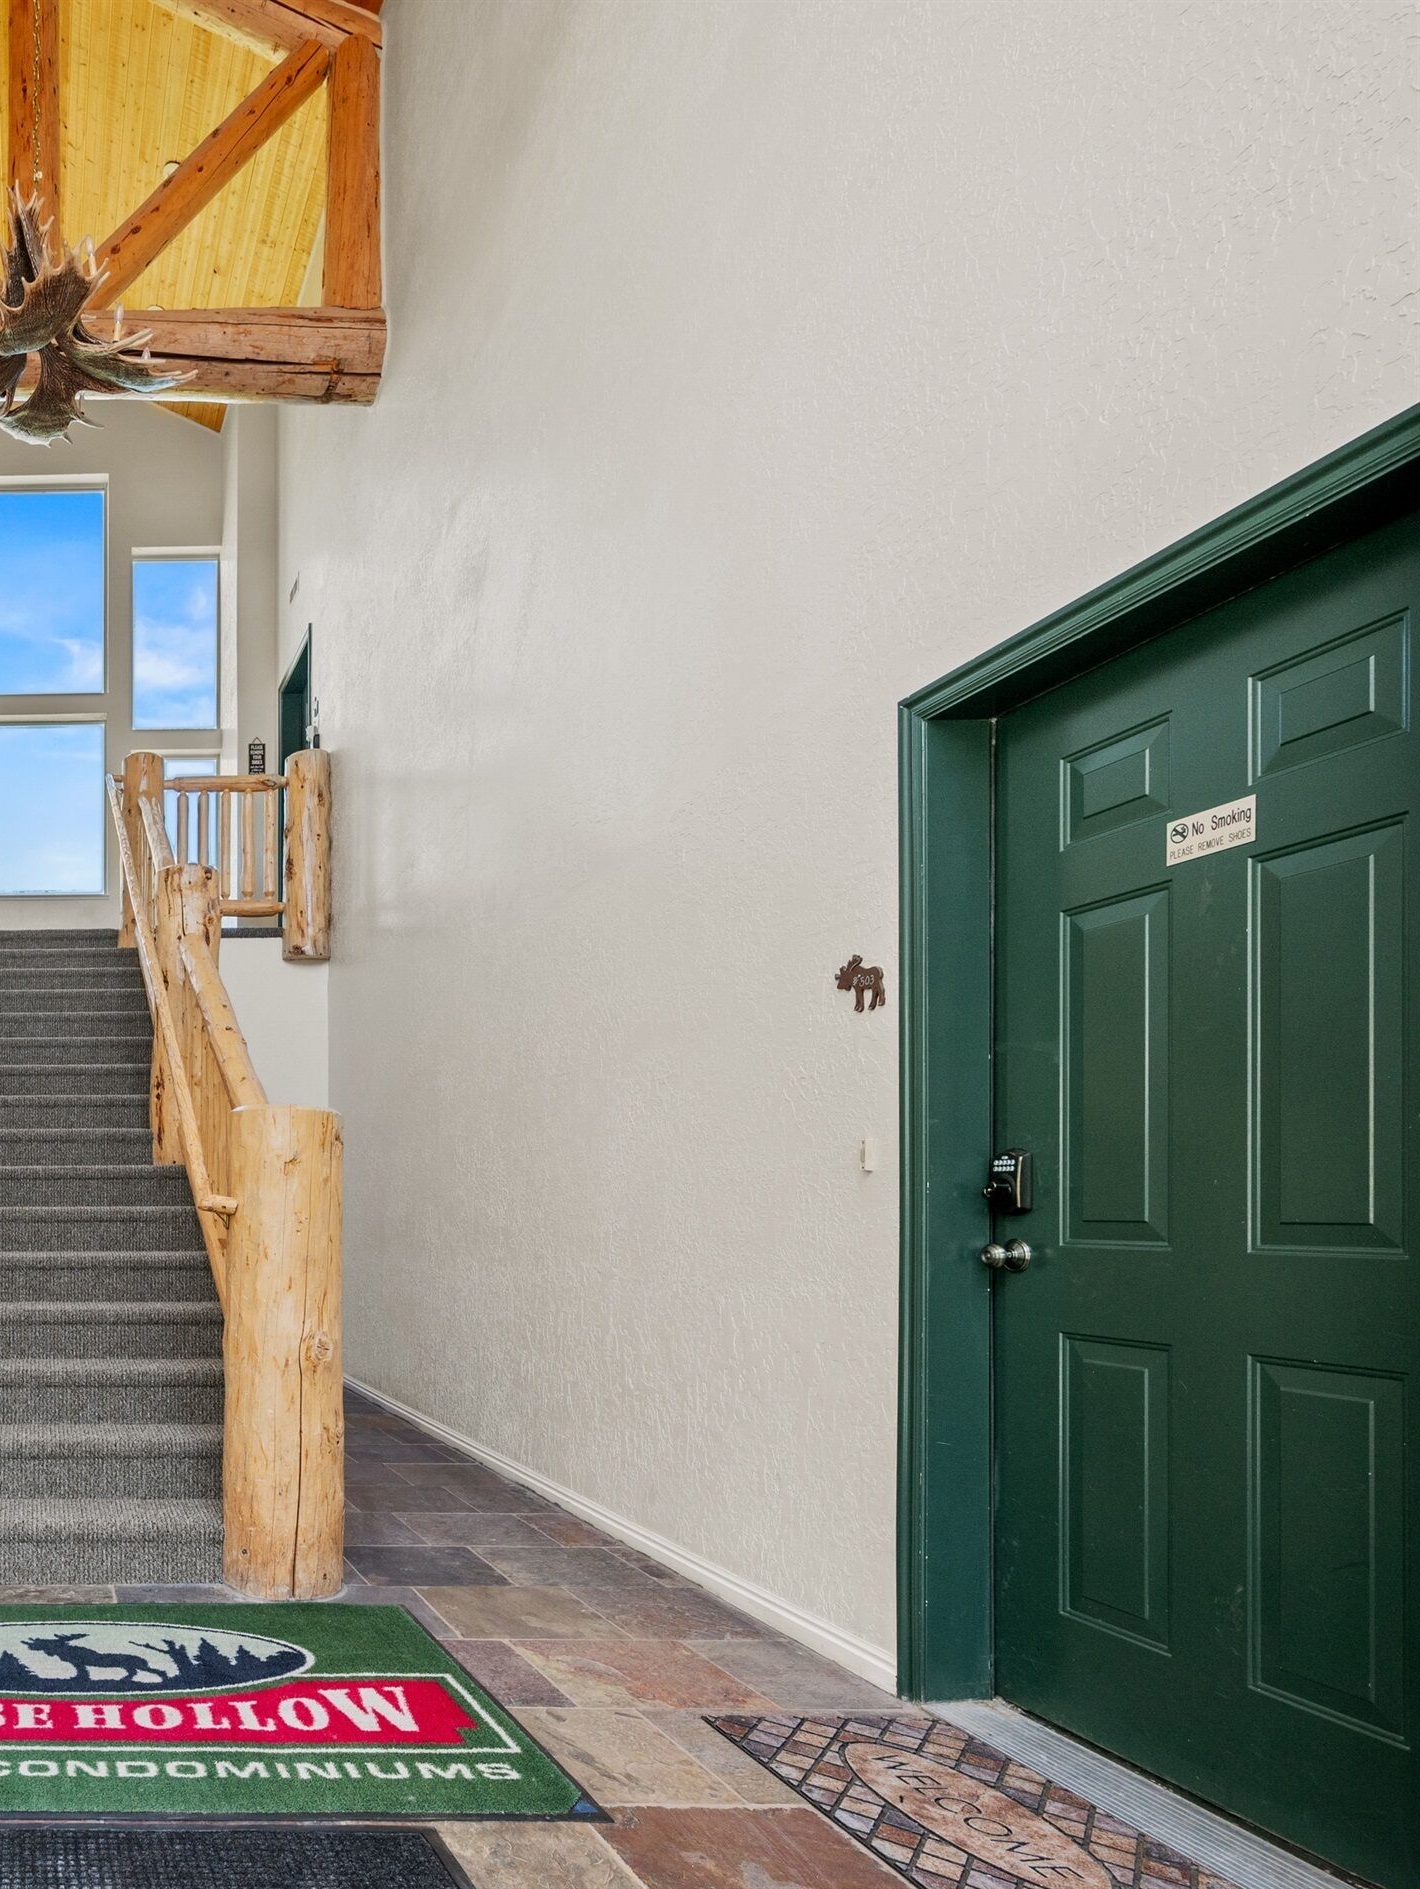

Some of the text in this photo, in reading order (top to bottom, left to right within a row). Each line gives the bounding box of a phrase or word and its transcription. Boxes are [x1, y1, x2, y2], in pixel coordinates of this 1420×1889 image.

[1191, 807, 1252, 837] No Smoking
[1169, 827, 1252, 860] PLEASE REMOVE SHOES
[71, 1684, 420, 1733] HOLLOW
[871, 1754, 1085, 1879] WELCOME
